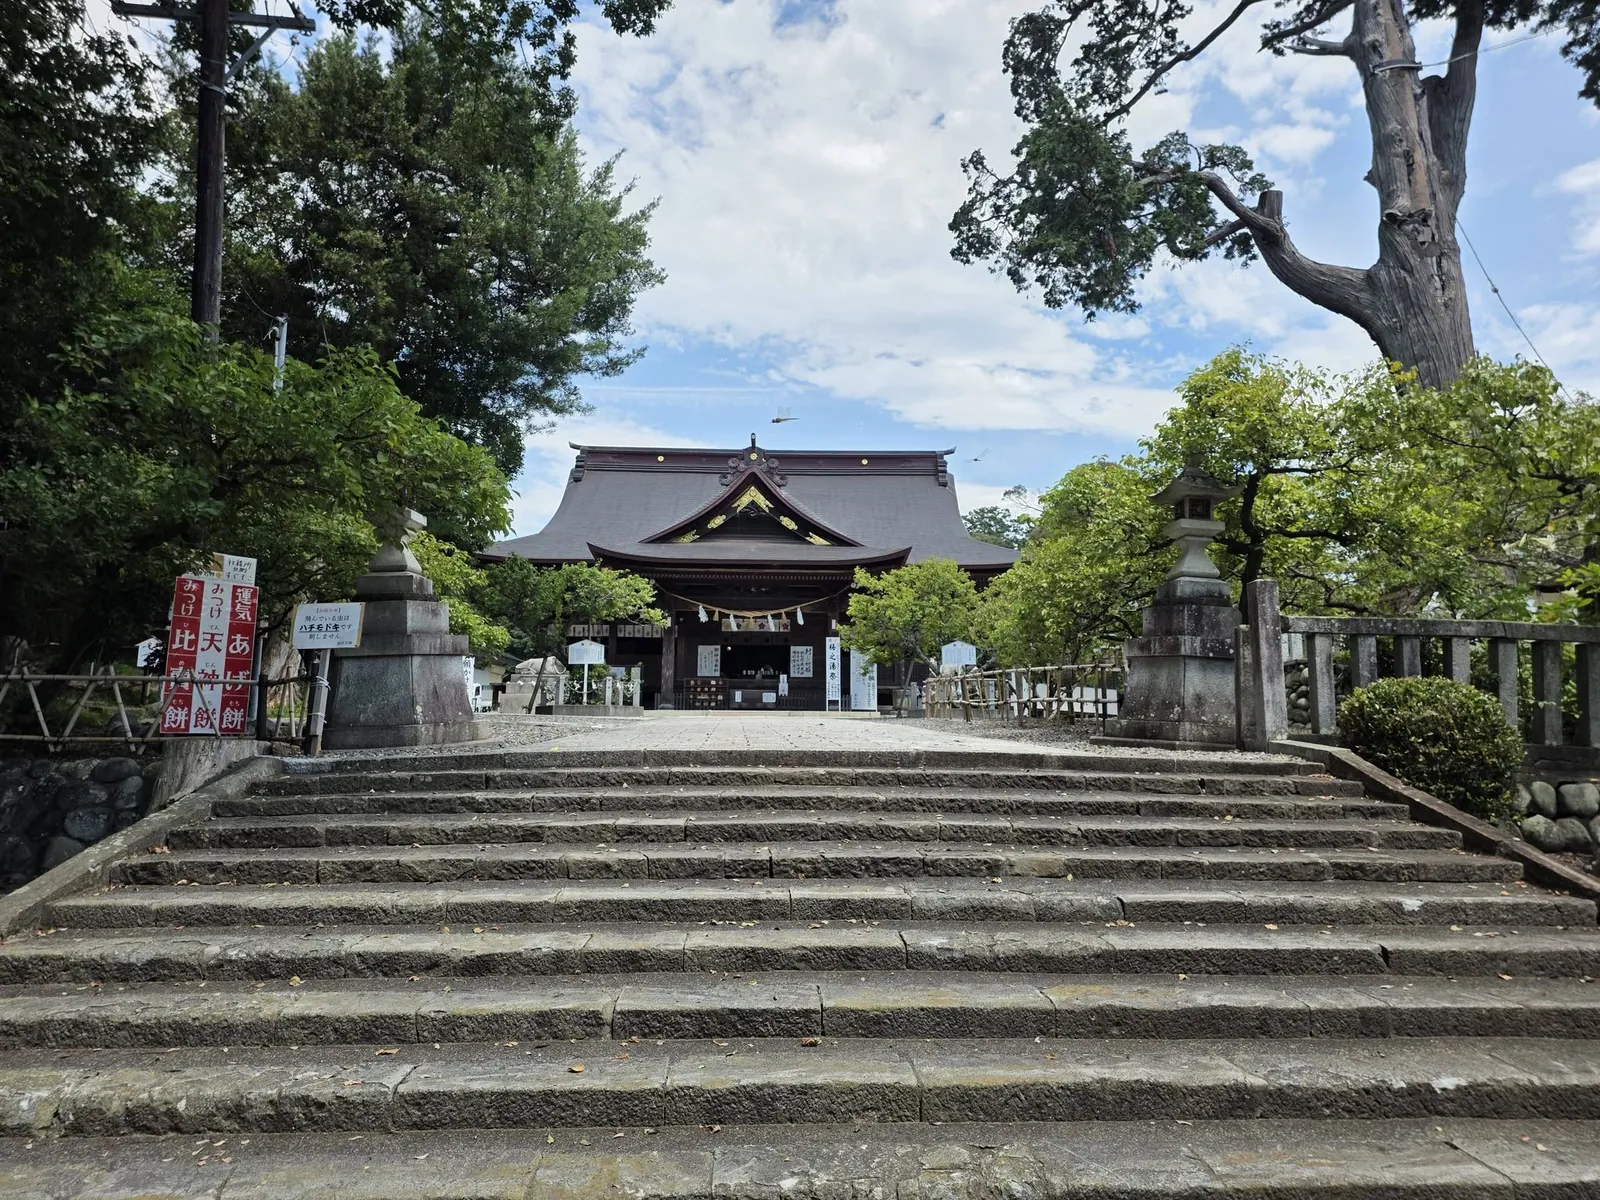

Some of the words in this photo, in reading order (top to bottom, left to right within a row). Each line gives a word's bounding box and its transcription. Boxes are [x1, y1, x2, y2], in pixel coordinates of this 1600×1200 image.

[299, 623, 353, 632] ハチモドキです
